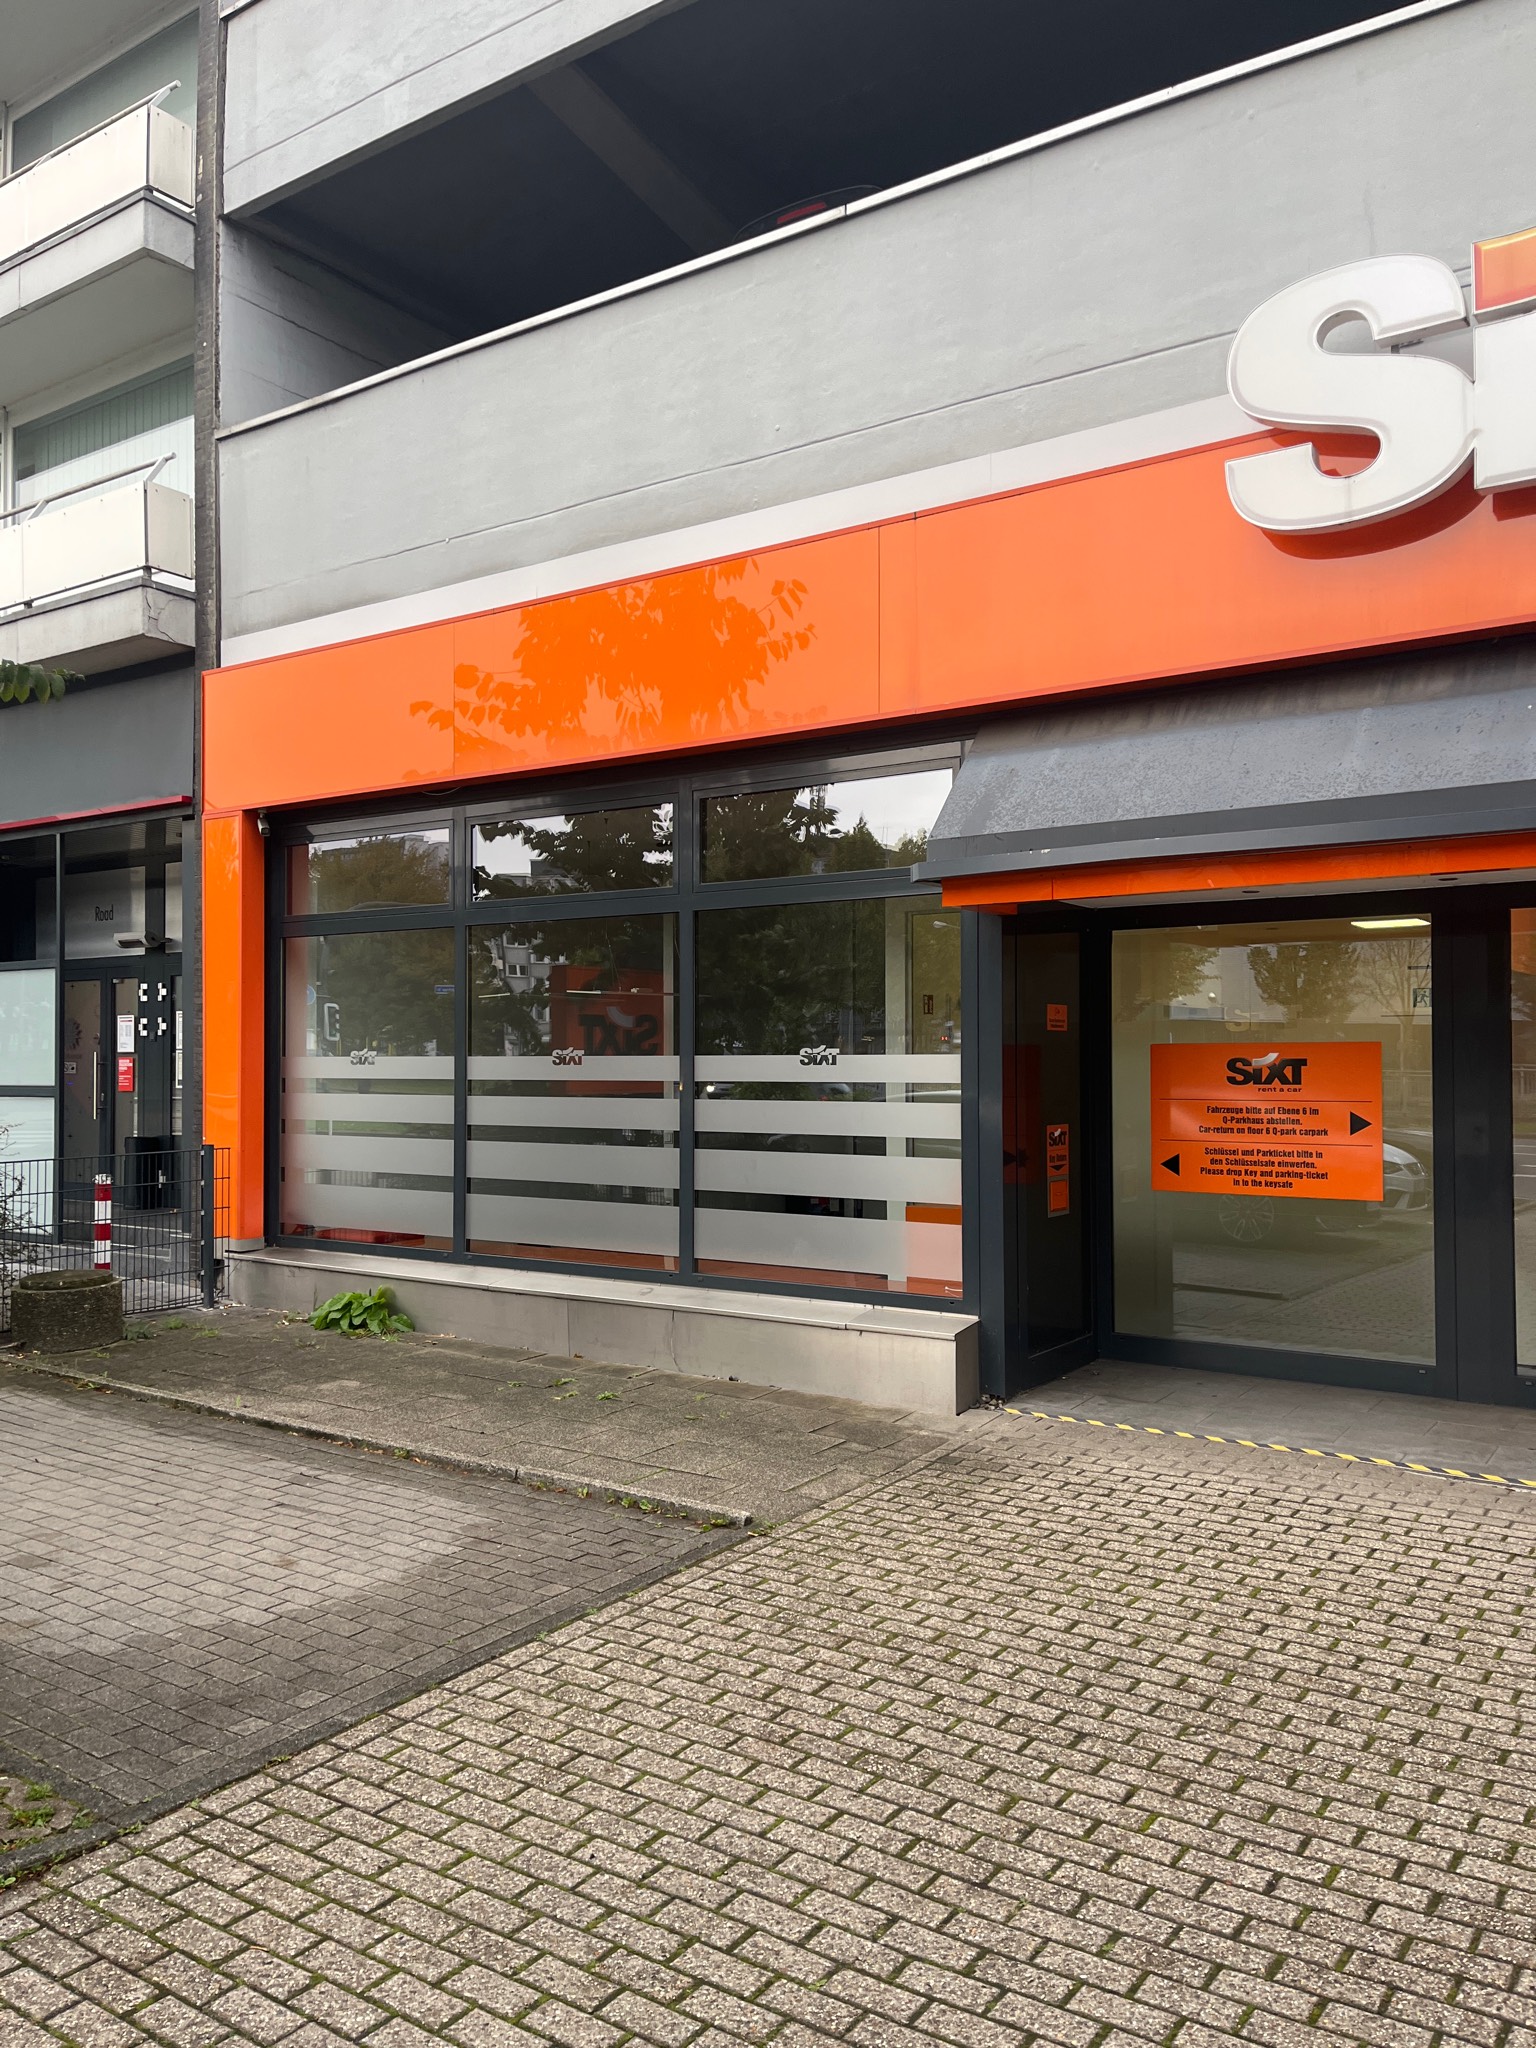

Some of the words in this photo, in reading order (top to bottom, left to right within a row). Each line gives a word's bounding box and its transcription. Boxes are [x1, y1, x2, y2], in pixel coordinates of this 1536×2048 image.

[1206, 1105, 1244, 1115] Fahrzeuge
[1245, 1106, 1262, 1115] bitte
[1264, 1107, 1276, 1115] auf
[1277, 1107, 1301, 1115] Ebene
[1302, 1107, 1308, 1116] 6
[1222, 1115, 1265, 1125] Q-Parkhaus
[1266, 1116, 1303, 1126] abstellen.
[1199, 1125, 1235, 1134] Car-return
[1247, 1126, 1264, 1135] floor
[1265, 1127, 1271, 1135] 6
[1272, 1127, 1297, 1136] Q-park
[1299, 1128, 1329, 1137] carpark
[1204, 1146, 1239, 1156] Schlüssel
[1241, 1148, 1255, 1156] und
[1256, 1148, 1295, 1158] Parkticket
[1296, 1150, 1314, 1158] bitte
[1315, 1150, 1323, 1159] in
[1210, 1157, 1223, 1165] den
[1225, 1158, 1275, 1167] Schlüsselsafe
[1277, 1160, 1318, 1169] einwerfen.
[1200, 1166, 1225, 1175] Please
[1226, 1168, 1242, 1177] drop
[1244, 1168, 1258, 1177] Key
[1259, 1170, 1273, 1178] and
[1275, 1170, 1329, 1180] parking-ticket
[1242, 1179, 1249, 1187] to
[1251, 1179, 1263, 1187] the
[1264, 1180, 1293, 1189] keysafe
